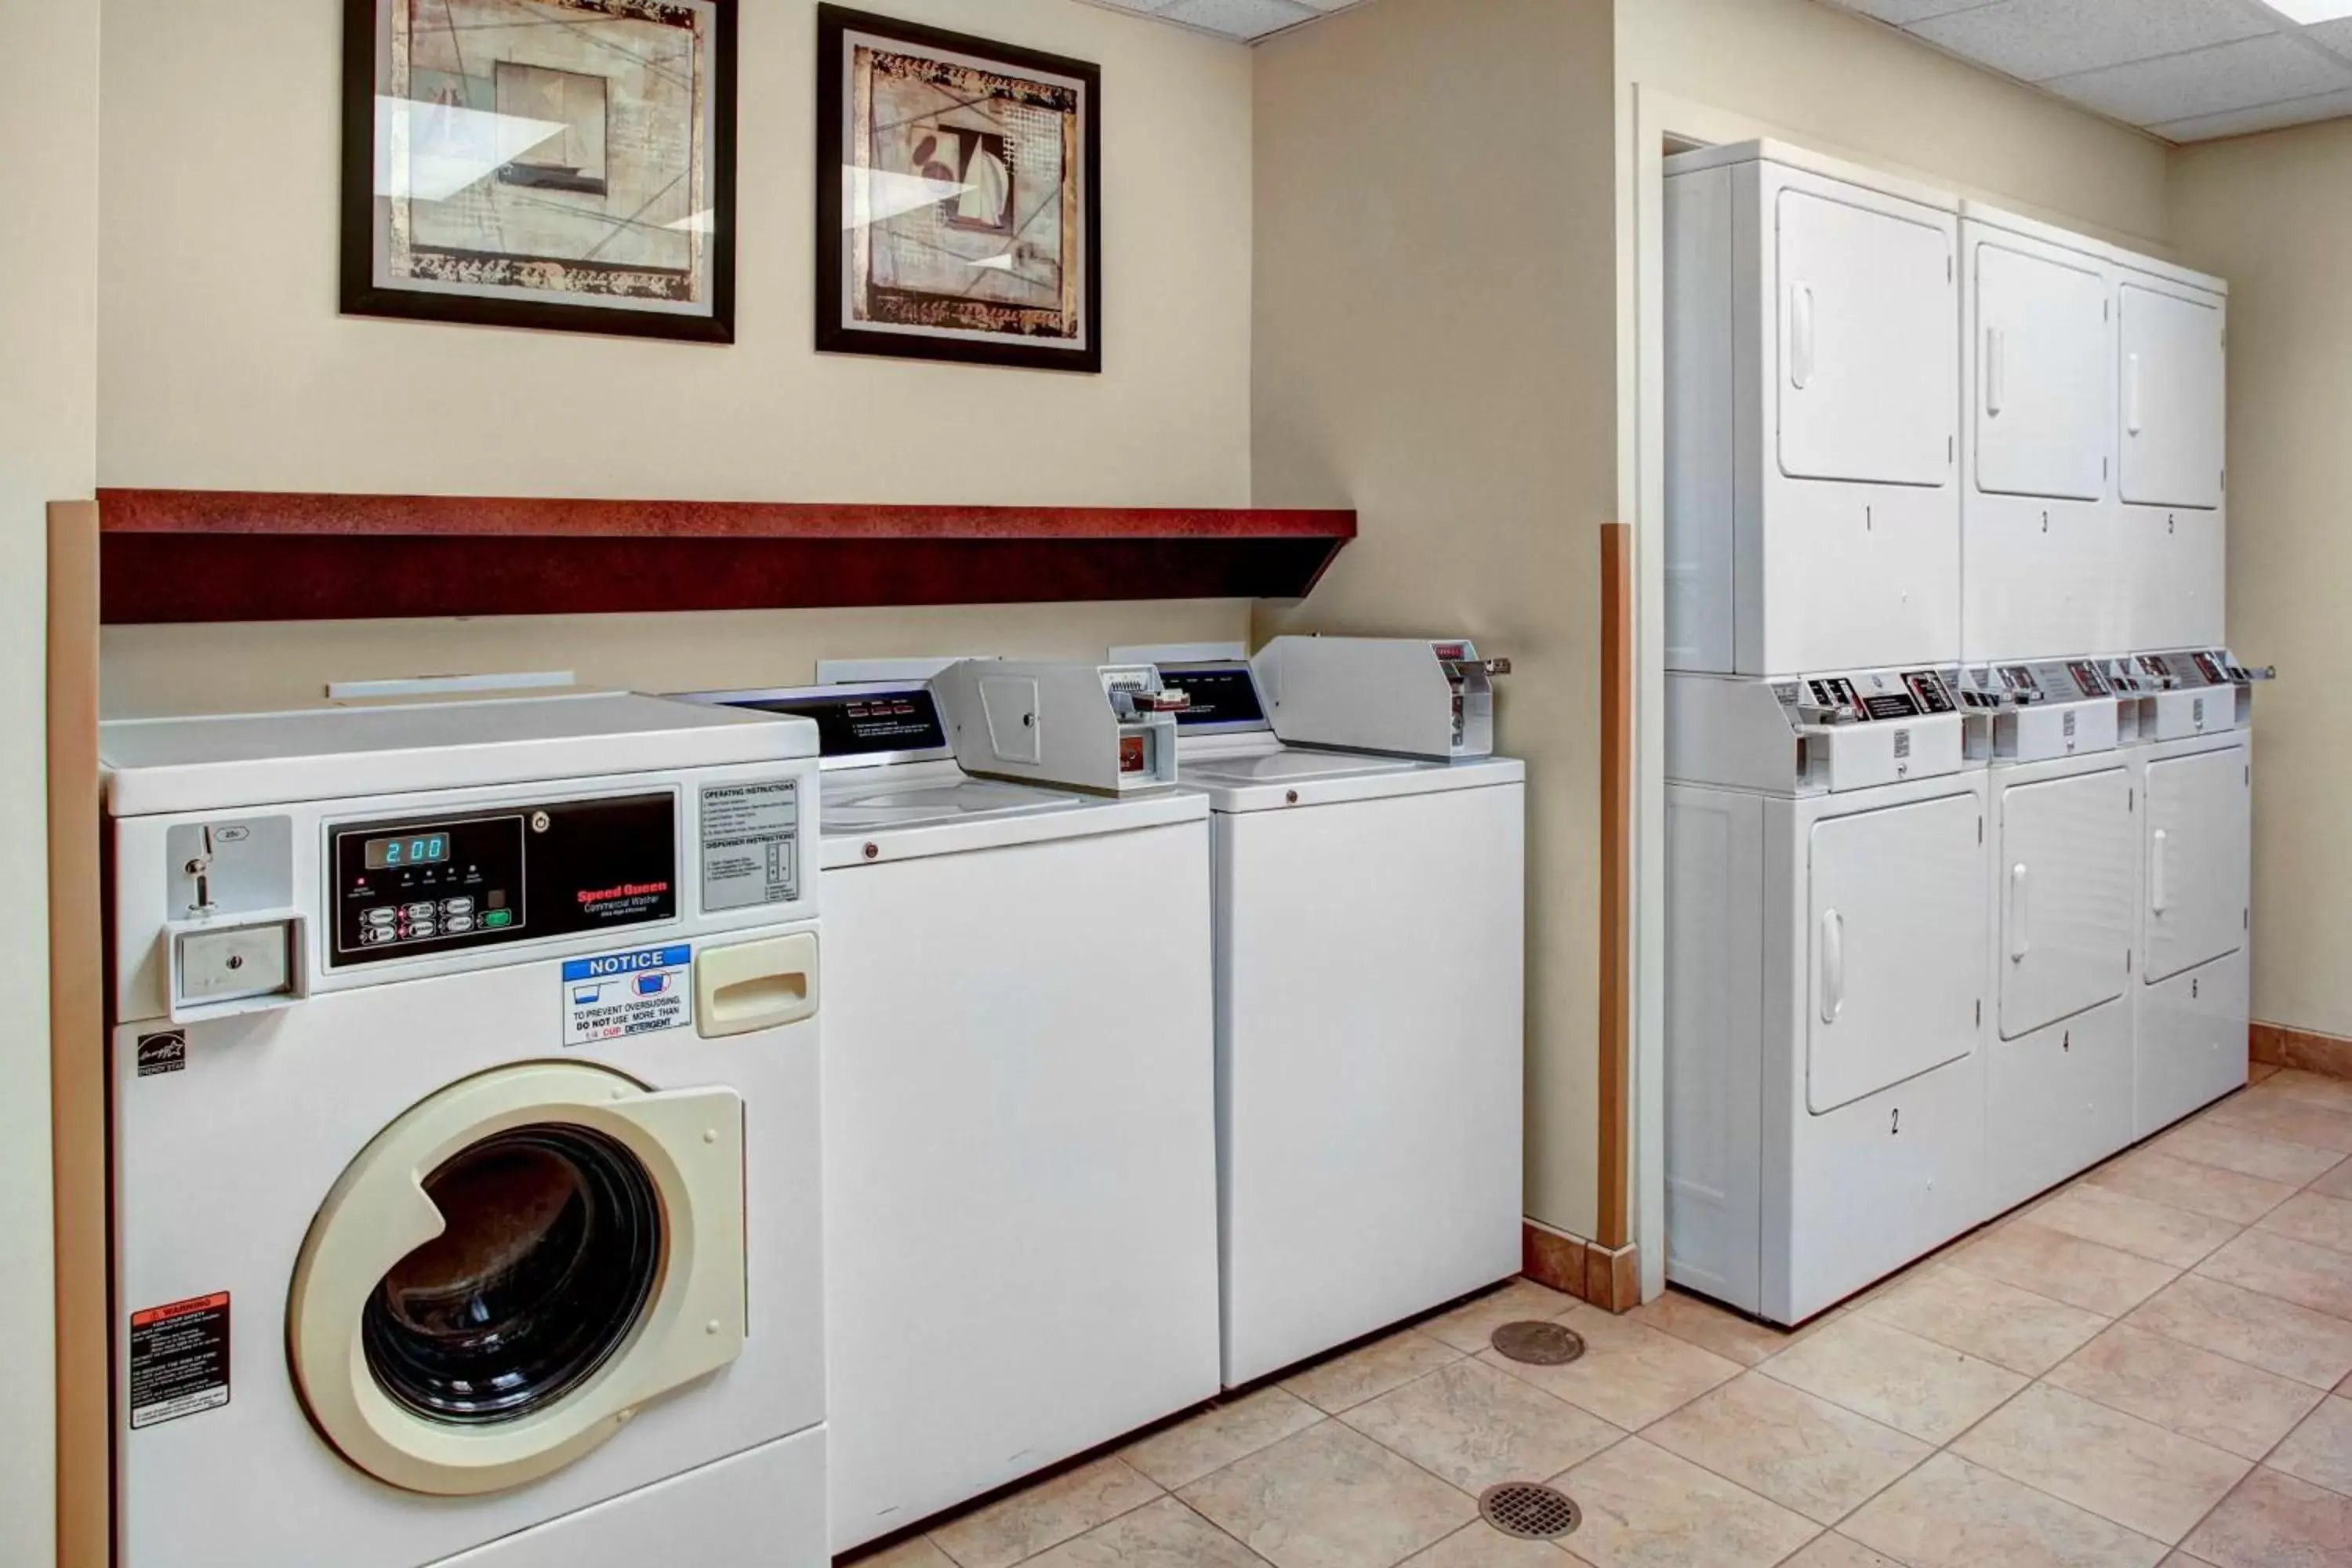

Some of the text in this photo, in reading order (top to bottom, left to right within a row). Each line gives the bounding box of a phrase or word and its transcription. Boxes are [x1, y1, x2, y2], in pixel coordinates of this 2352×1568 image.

[2042, 510, 2048, 533] 3
[2168, 513, 2175, 534] 5
[705, 783, 794, 799] OPERATING INSTRUCTIONS
[746, 833, 795, 844] INSTRUCTIONS
[577, 881, 667, 903] Speed Queen
[584, 899, 630, 913] Commercial
[631, 895, 659, 906] Washer
[590, 951, 664, 975] NOTICE
[574, 1011, 585, 1021] TO
[586, 1004, 623, 1019] PREVENT
[576, 1007, 680, 1031] DO NOT USE MORE THAN
[603, 1027, 622, 1036] CUP
[625, 1018, 672, 1033] DETERGENT
[2063, 1029, 2069, 1053] 4
[1891, 1107, 1899, 1135] 2
[162, 1298, 211, 1316] WARNING
